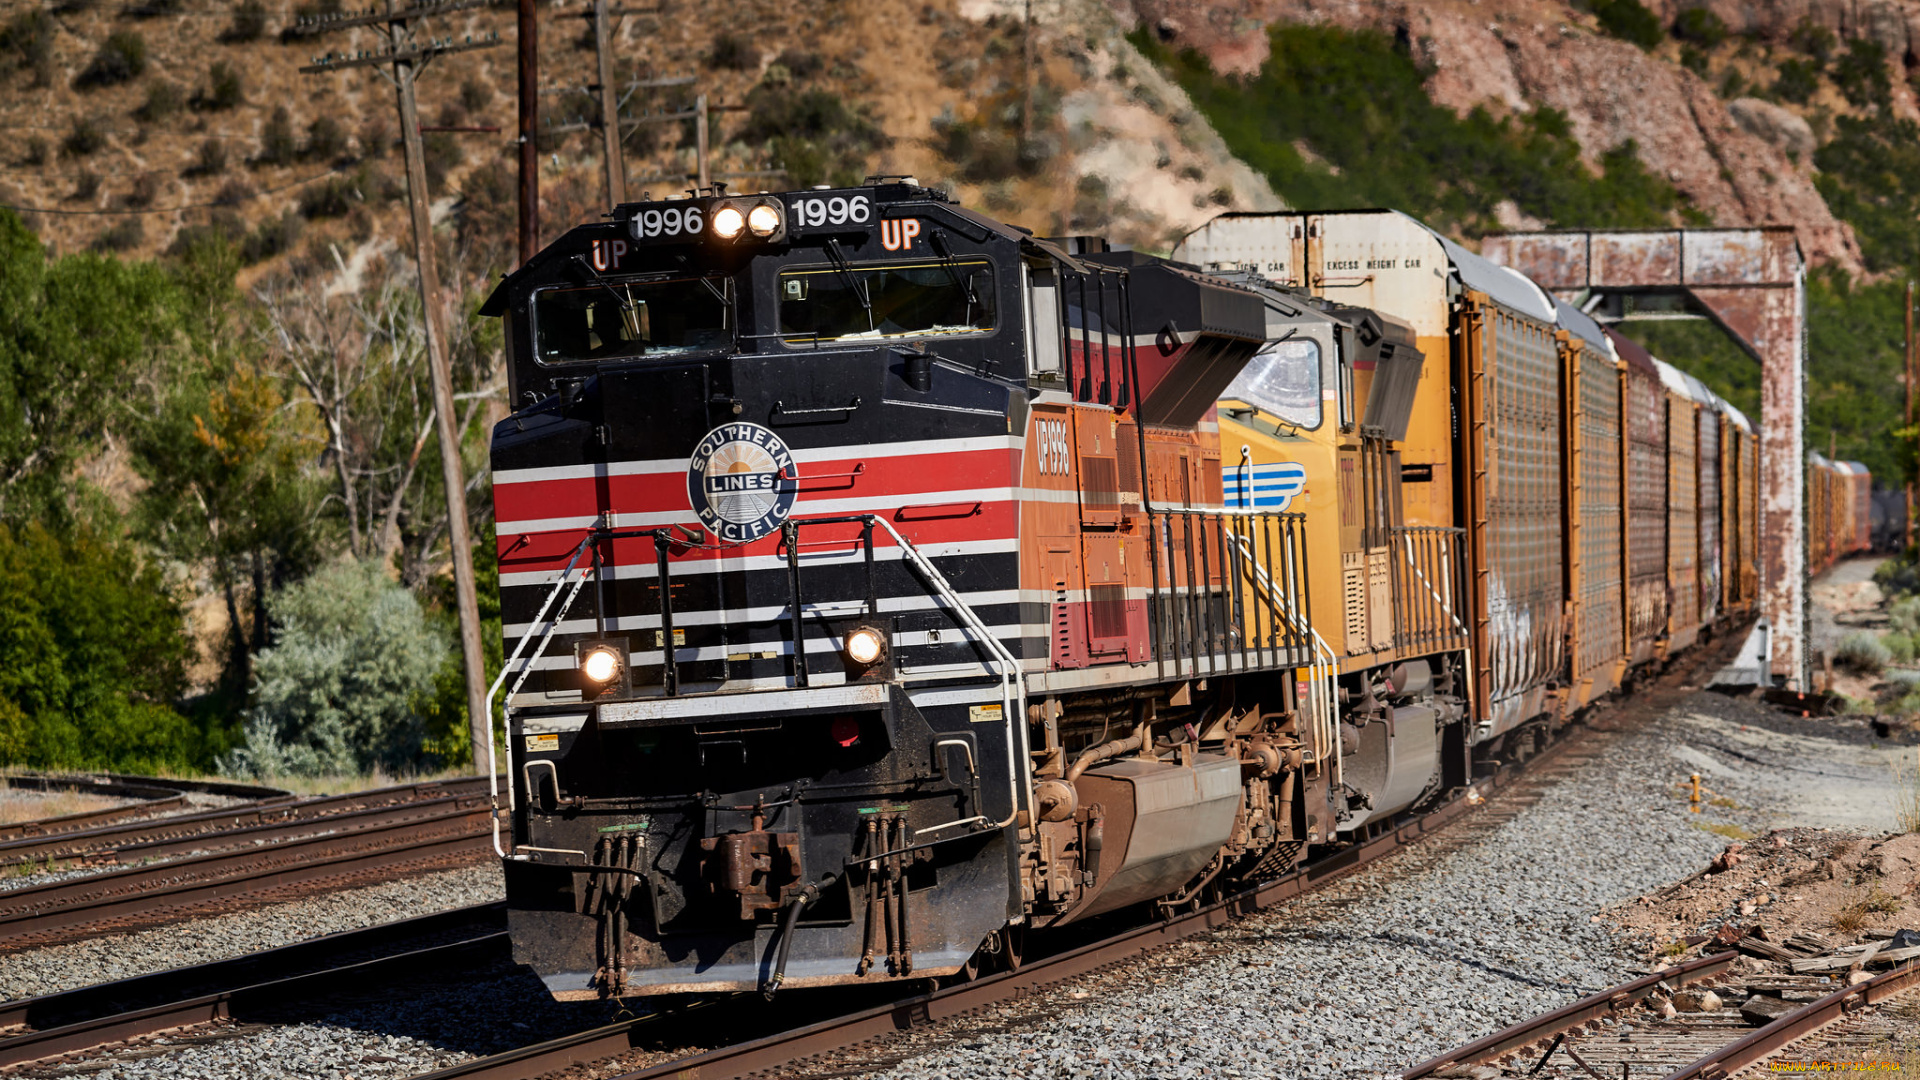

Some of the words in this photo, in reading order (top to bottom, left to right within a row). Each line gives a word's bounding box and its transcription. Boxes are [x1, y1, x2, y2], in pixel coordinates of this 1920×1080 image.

[631, 206, 703, 239] 1996
[791, 195, 870, 227] 1996
[881, 218, 921, 251] UP
[592, 239, 628, 272] UP
[1267, 262, 1285, 272] CAR
[1327, 261, 1360, 270] EXCESS
[1366, 259, 1396, 269] HEIGHT
[1404, 259, 1421, 269] CAR
[692, 425, 791, 472] SOUTHERN
[711, 474, 773, 492] LINES
[699, 502, 788, 539] PACIFIC
